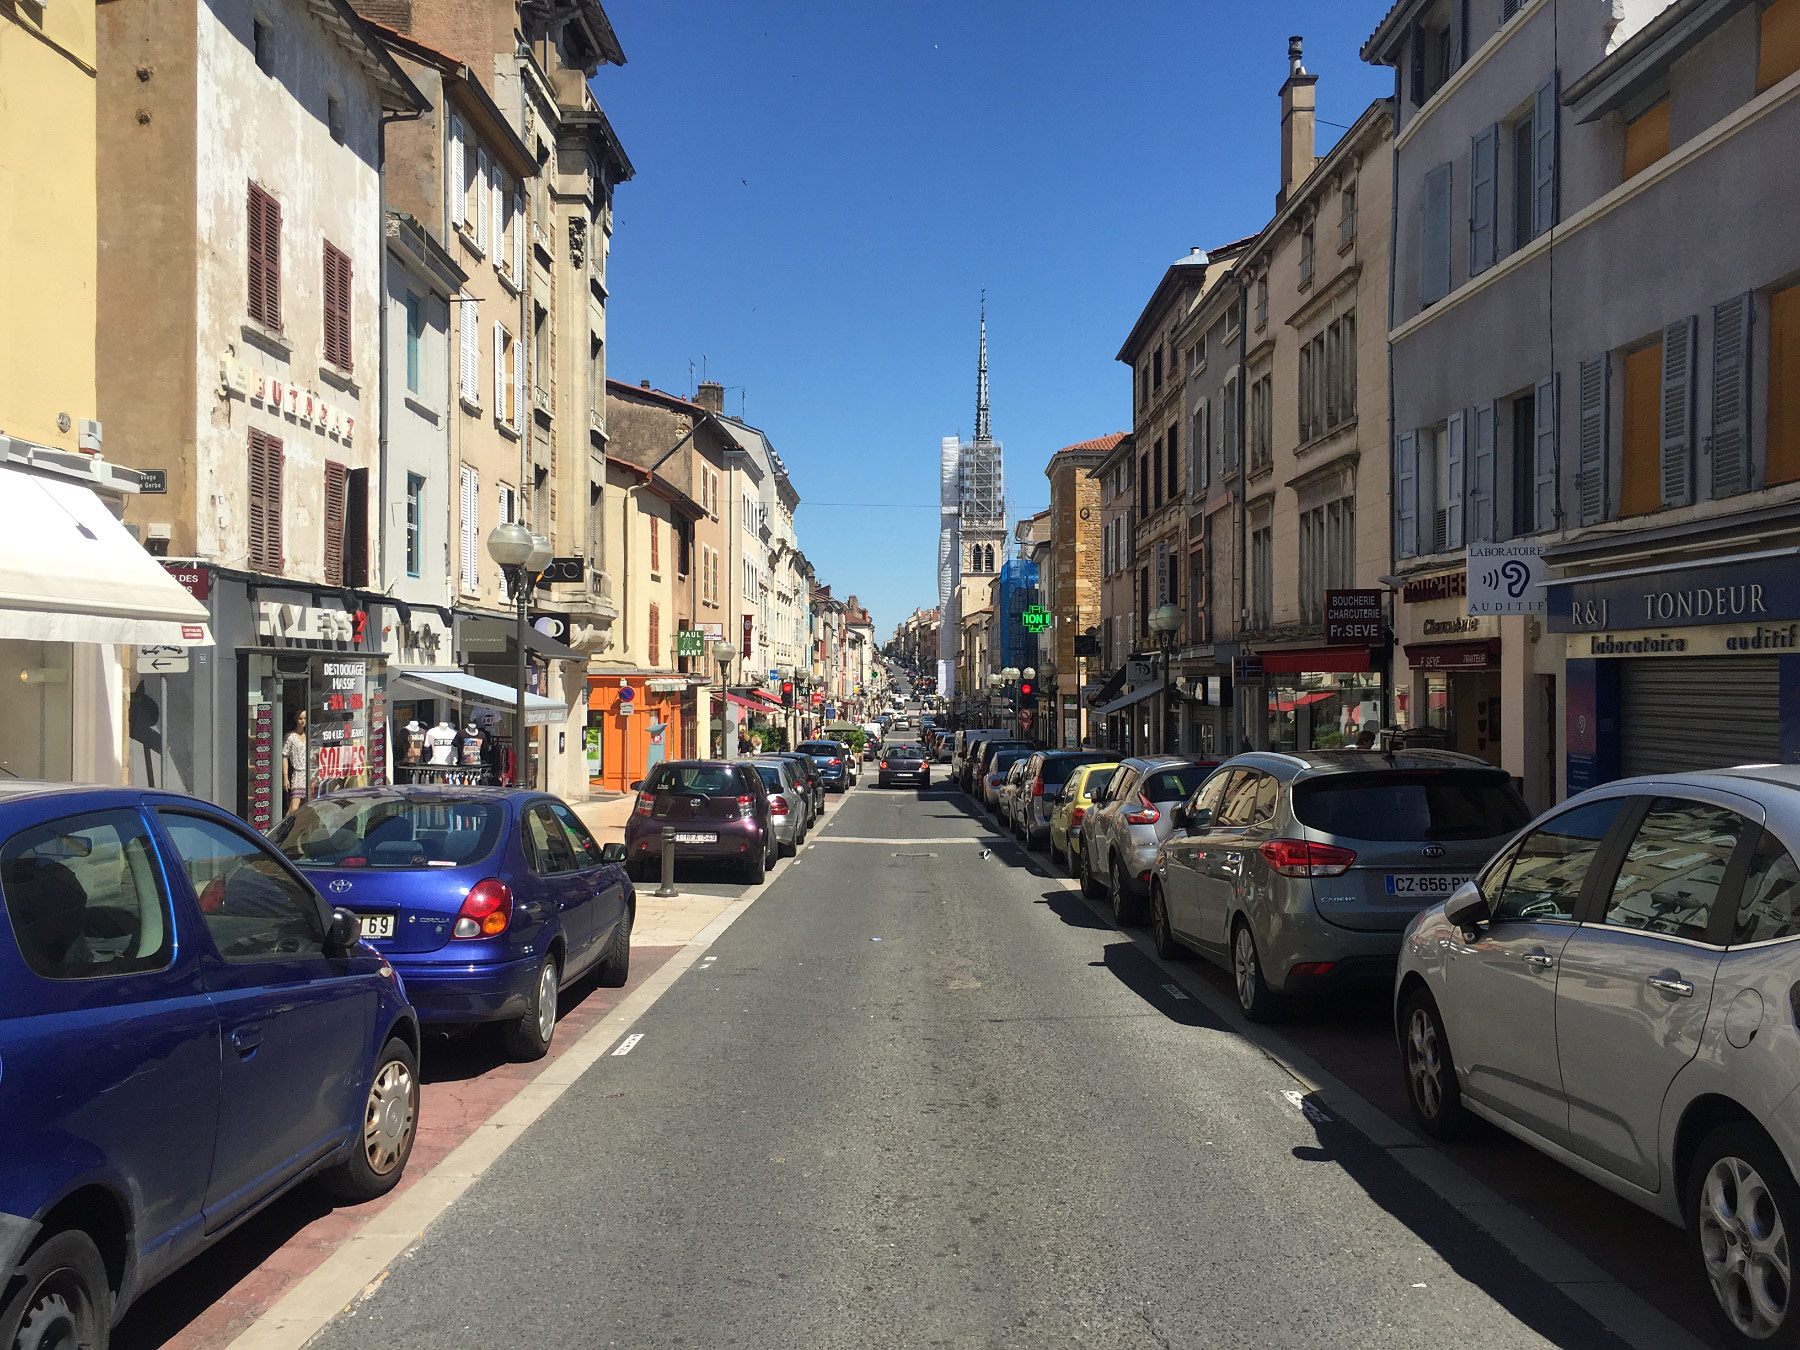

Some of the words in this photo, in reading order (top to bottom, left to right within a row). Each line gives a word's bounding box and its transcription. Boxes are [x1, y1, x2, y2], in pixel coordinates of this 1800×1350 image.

[1470, 547, 1543, 557] LABORATOIRE
[179, 574, 199, 582] DES
[1332, 596, 1376, 606] BOUCHERIE
[1470, 602, 1544, 612] AUDITIF
[1572, 598, 1610, 629] R&J
[1643, 583, 1768, 620] TONDEUR
[1328, 608, 1380, 619] CHARCUTERIE
[1330, 624, 1378, 637] Fr.SEVE
[1590, 633, 1687, 654] laboratoire
[1726, 624, 1798, 651] auditif
[324, 663, 364, 676] DESTOCKAGE
[332, 677, 356, 690] MASSIF
[344, 722, 351, 739] 2
[319, 745, 365, 780] SOLDES
[1426, 849, 1444, 857] KIA
[368, 917, 389, 934] 69
